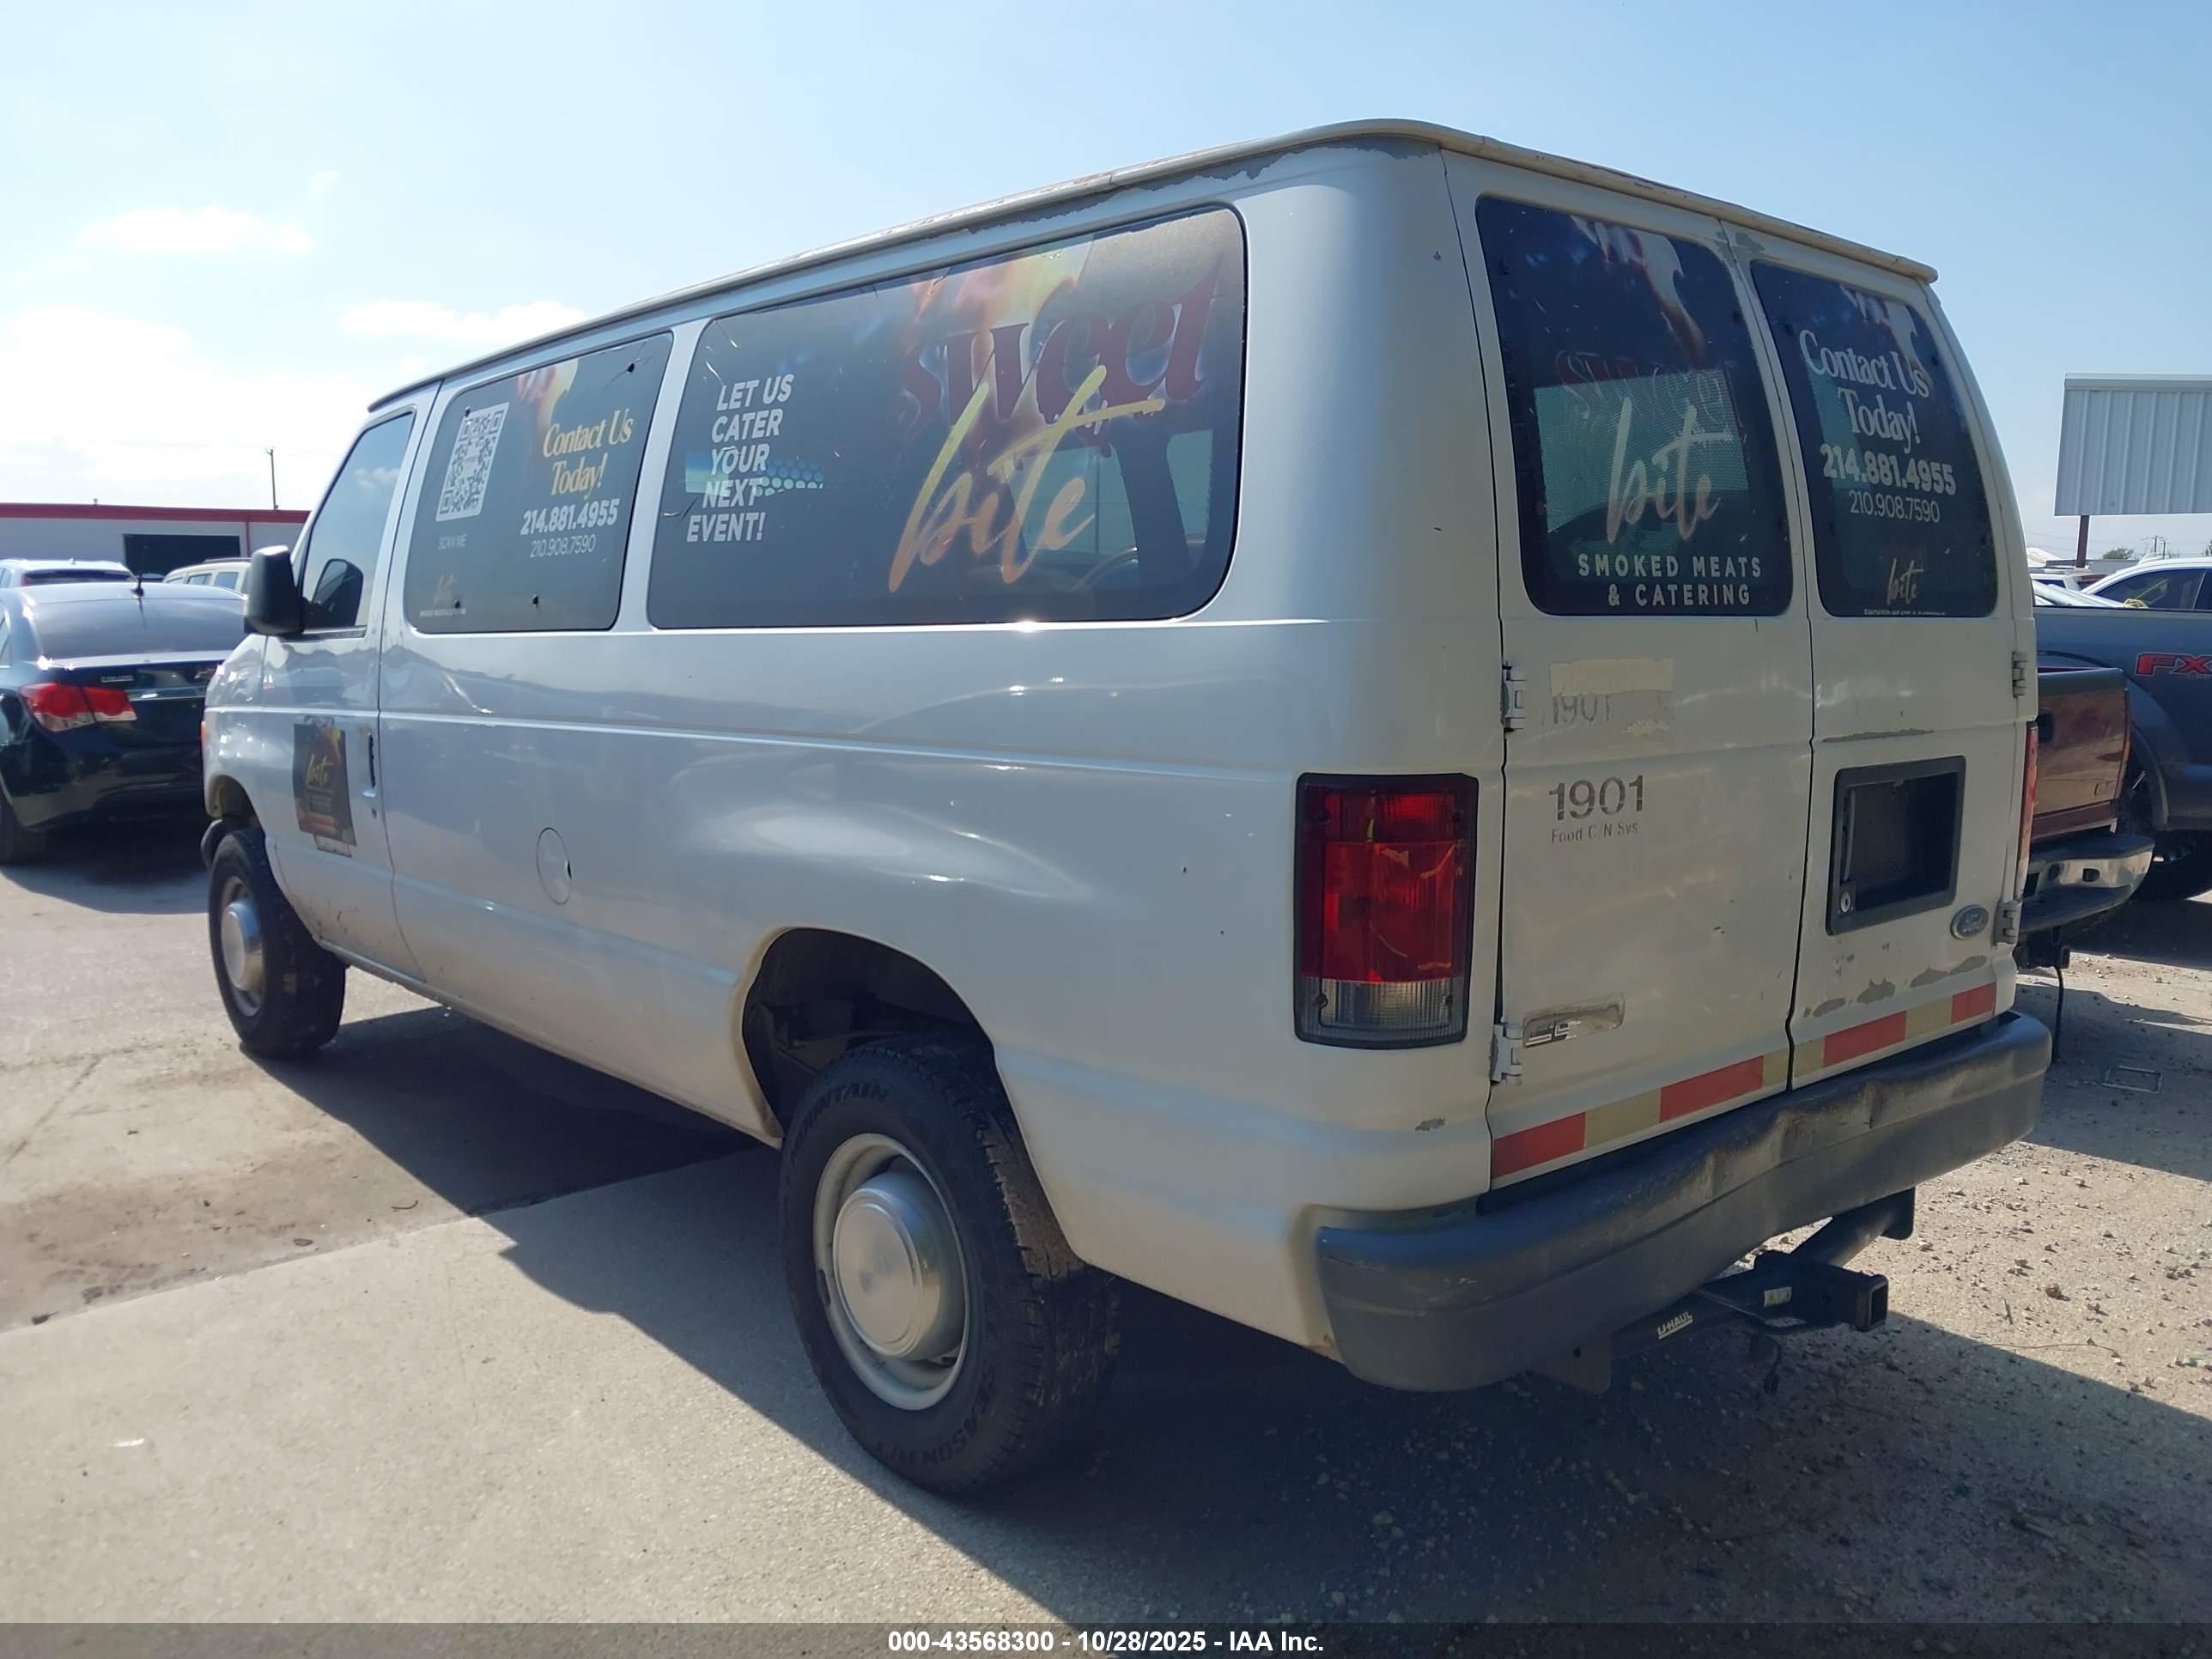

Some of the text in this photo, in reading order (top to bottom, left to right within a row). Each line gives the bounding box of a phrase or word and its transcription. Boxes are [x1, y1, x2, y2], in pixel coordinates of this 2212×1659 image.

[1800, 330, 1929, 398] Contact Us
[716, 373, 794, 412] LET US
[543, 408, 634, 458] Contact Us
[711, 407, 784, 444] CATER
[1837, 386, 1922, 453] Today!
[550, 452, 609, 501] Today!
[709, 444, 770, 476] YOUR
[888, 365, 1165, 592] bite
[1607, 397, 1734, 544] bite
[1820, 442, 1958, 496] 214.881.4955
[702, 477, 763, 507] NEXT
[1848, 489, 1942, 524] 210.908.7590
[520, 498, 621, 536] 214.881.4955
[686, 511, 767, 544] EVENT!
[529, 534, 598, 558] 210.908.7590
[1577, 553, 1763, 578] SMOKED MEATS
[1607, 584, 1751, 606] & CATERING
[1548, 775, 1645, 821] 1901
[1658, 1311, 1693, 1336] U-HAUL
